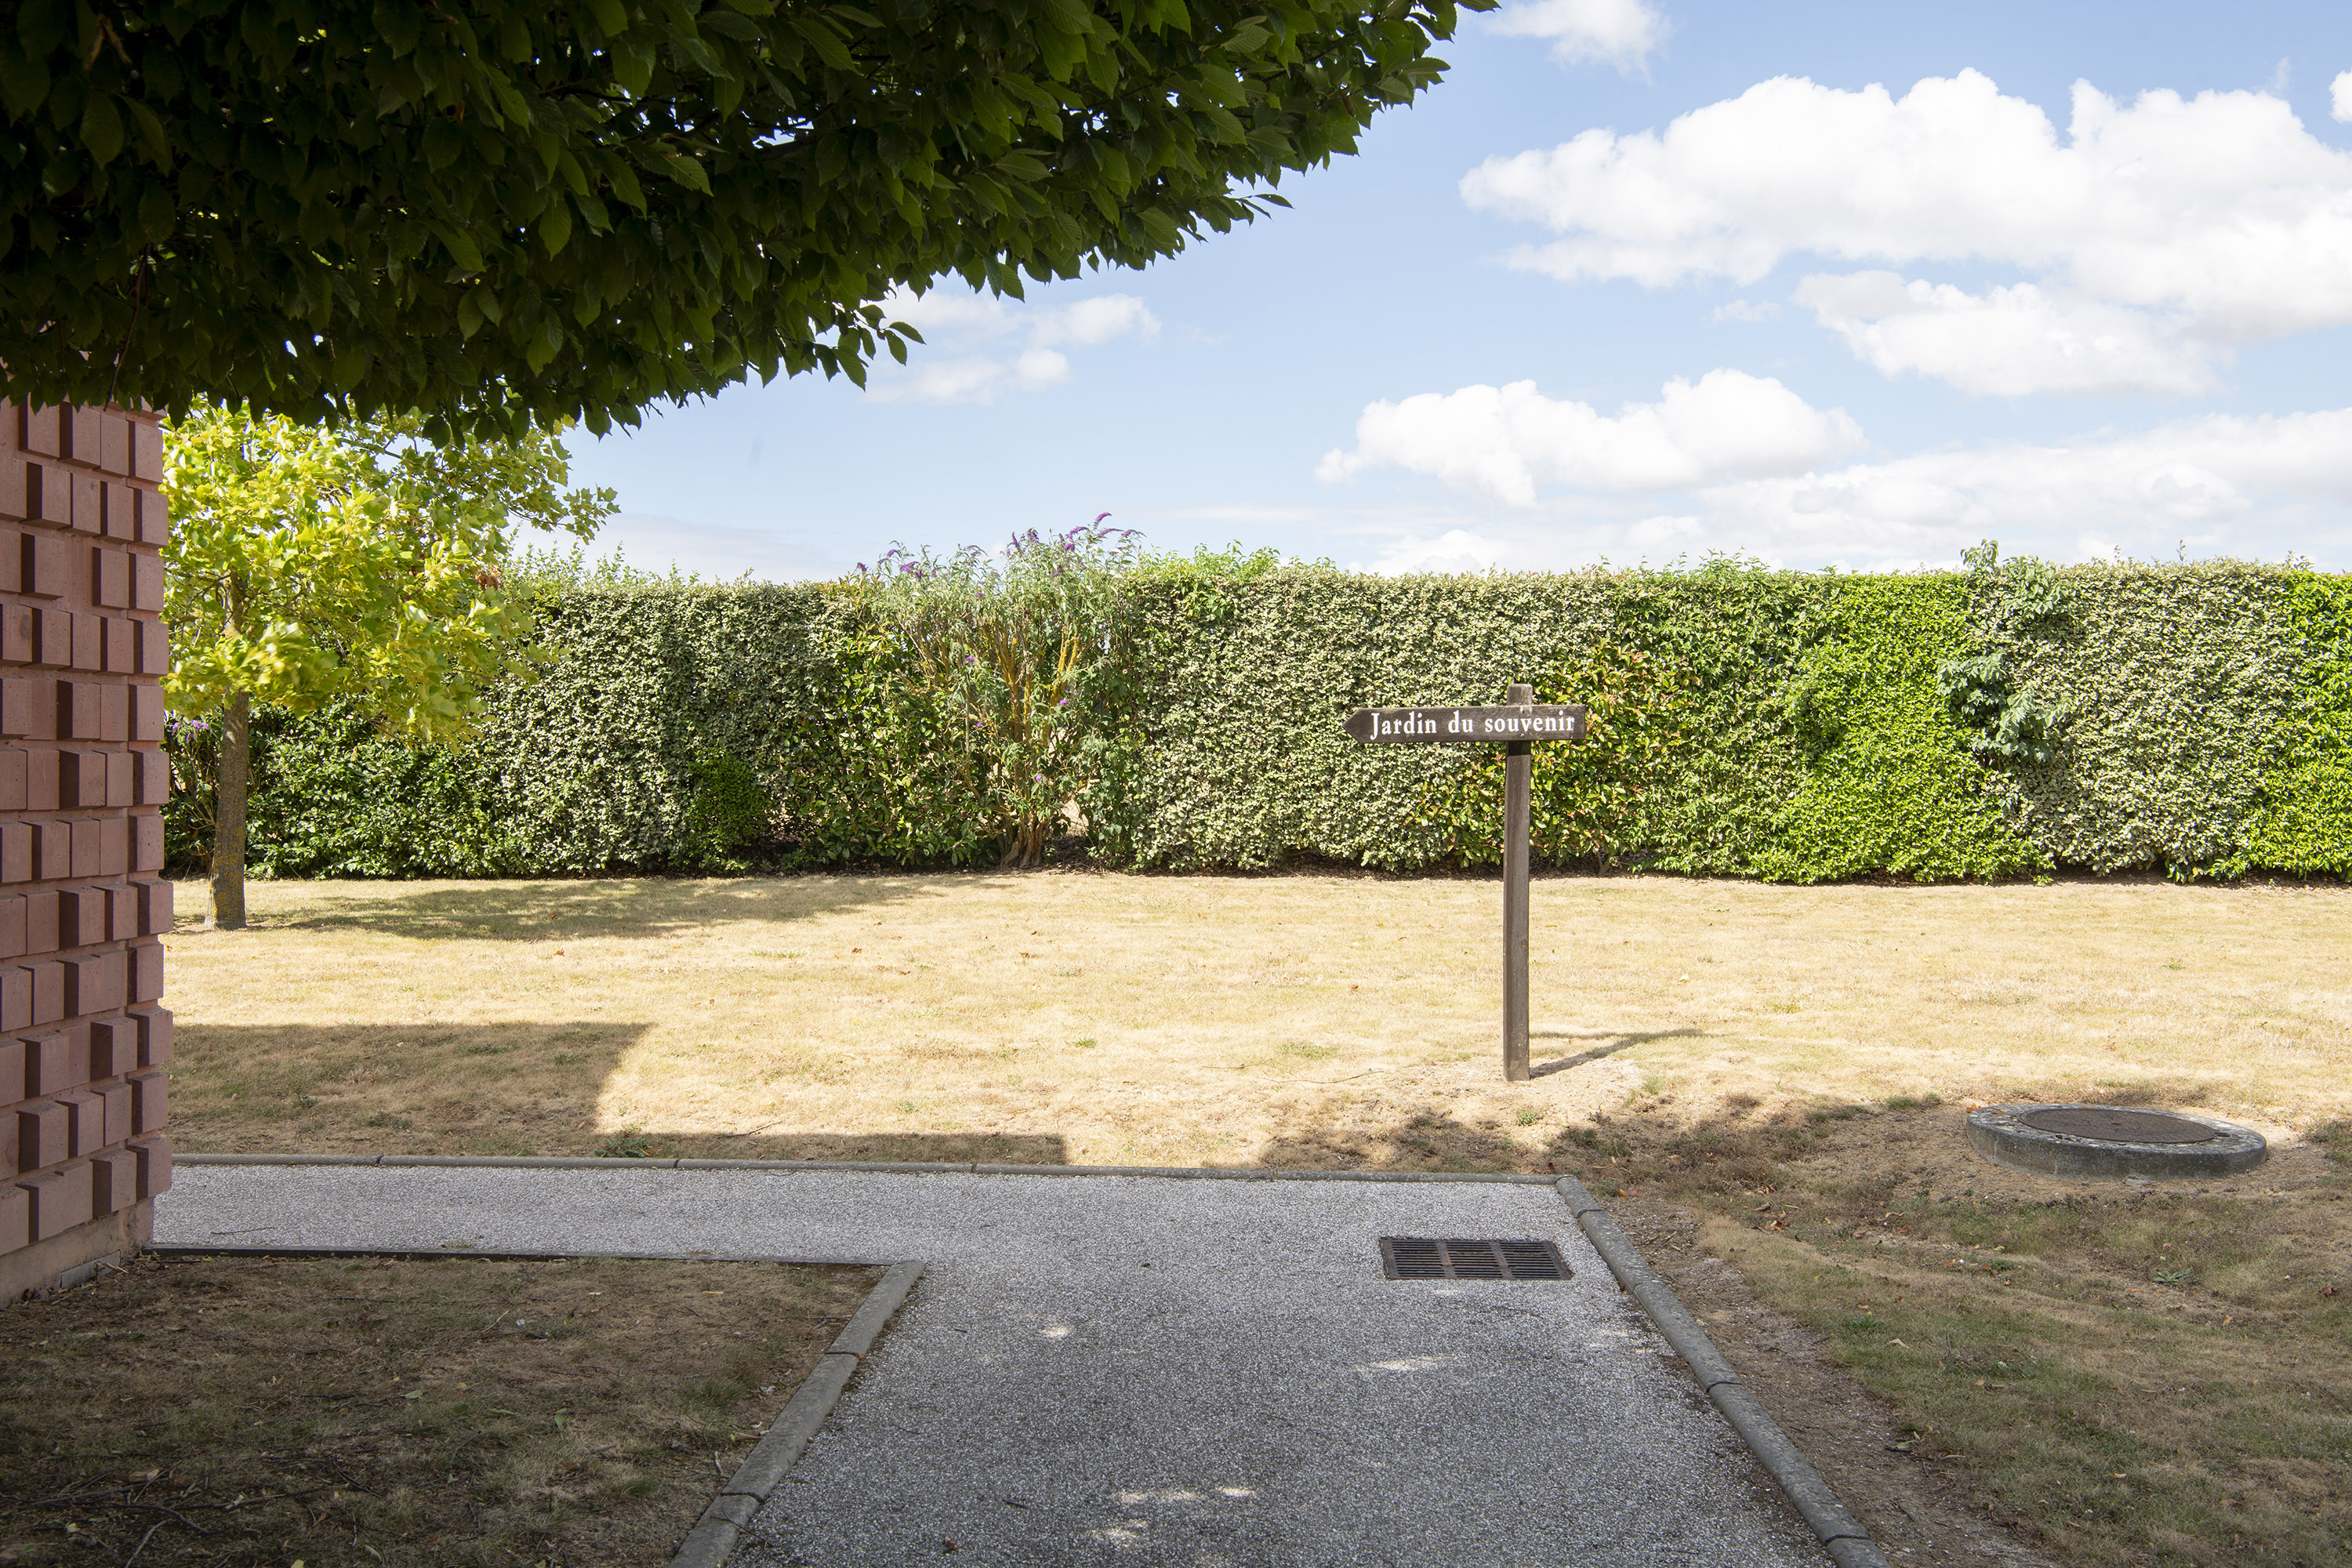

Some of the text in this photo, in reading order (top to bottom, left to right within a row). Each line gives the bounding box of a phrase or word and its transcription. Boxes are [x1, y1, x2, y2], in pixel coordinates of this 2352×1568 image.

[1370, 710, 1576, 740] Jardin du souvenir
